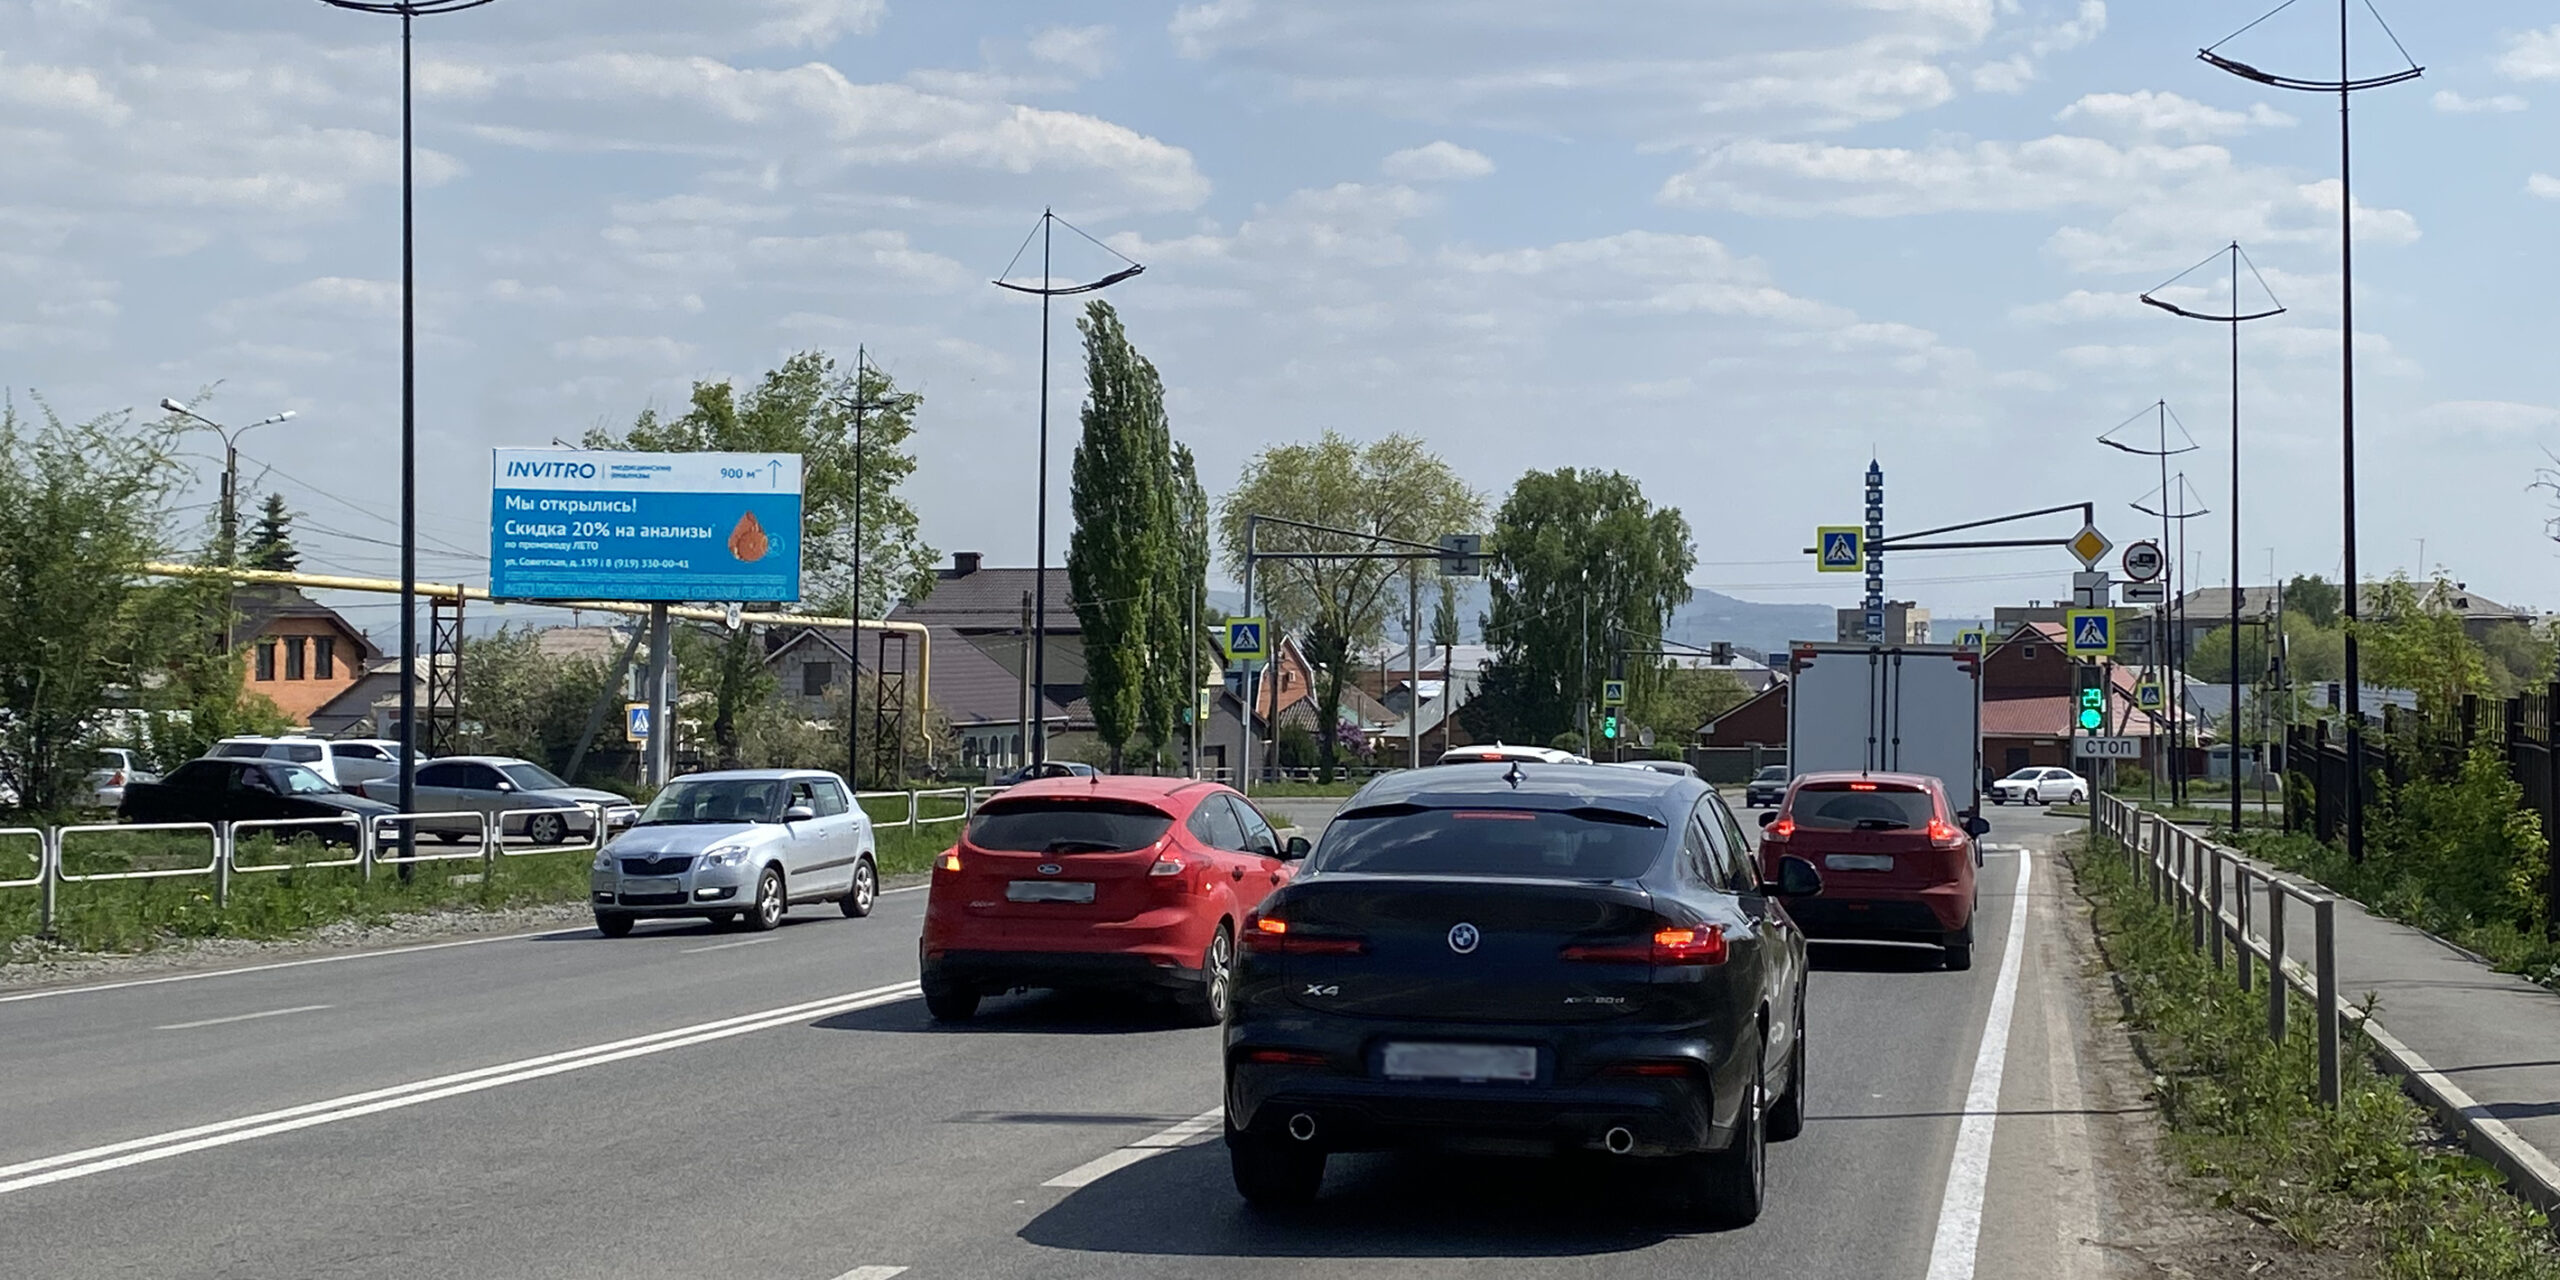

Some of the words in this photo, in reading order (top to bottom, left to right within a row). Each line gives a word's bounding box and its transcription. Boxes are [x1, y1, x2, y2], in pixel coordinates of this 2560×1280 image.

[507, 461, 596, 479] INVITRO
[720, 467, 743, 479] 900
[505, 495, 534, 511] Мы
[539, 497, 637, 515] открылись!
[504, 519, 566, 537] Скидка
[572, 521, 610, 537] 20%
[615, 525, 635, 537] на
[504, 541, 517, 549] по
[572, 541, 599, 551] ЛЕТО
[614, 558, 639, 570] (919)
[2082, 688, 2102, 708] 29
[2085, 740, 2131, 755] СТОП
[1301, 984, 1340, 997] X4
